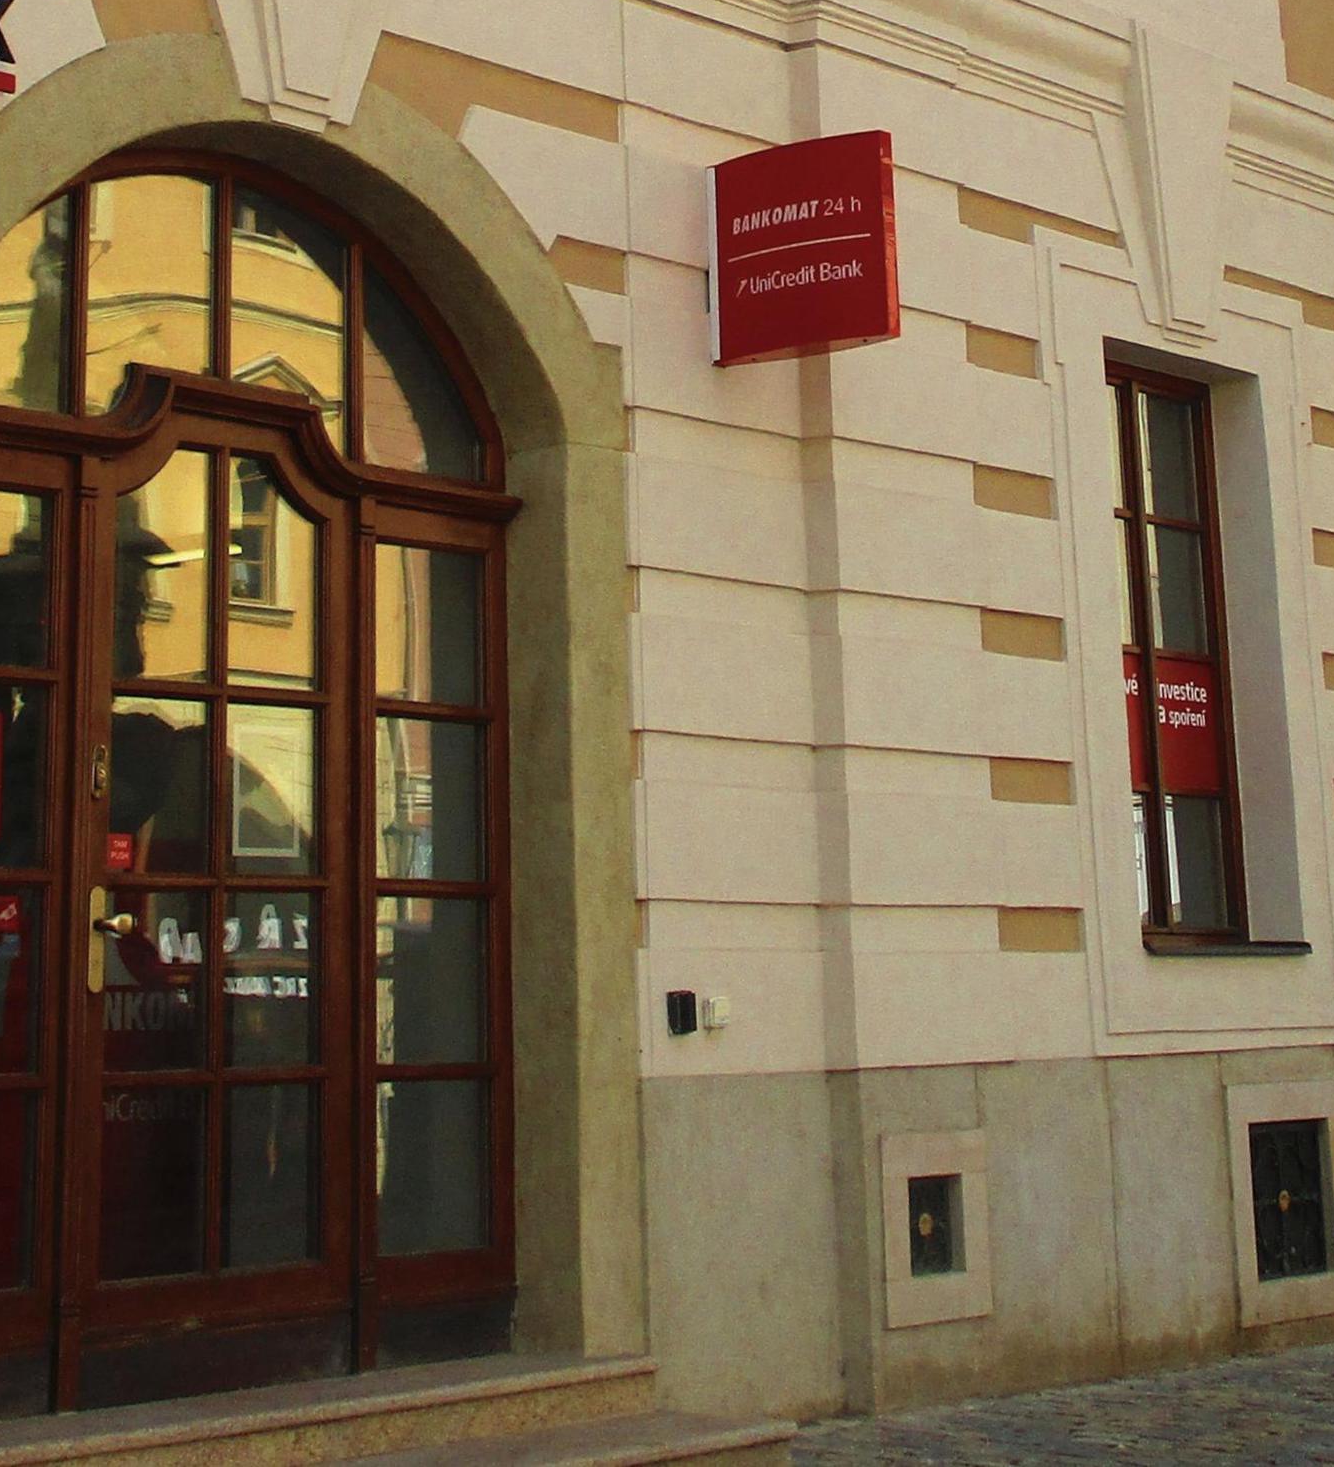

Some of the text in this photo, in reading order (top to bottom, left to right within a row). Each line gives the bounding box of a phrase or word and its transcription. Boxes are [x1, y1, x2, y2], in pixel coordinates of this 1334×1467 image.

[732, 196, 862, 235] BANKOMAT 24 h
[749, 259, 864, 295] UniCredit Bank
[1157, 681, 1208, 703] nvestice
